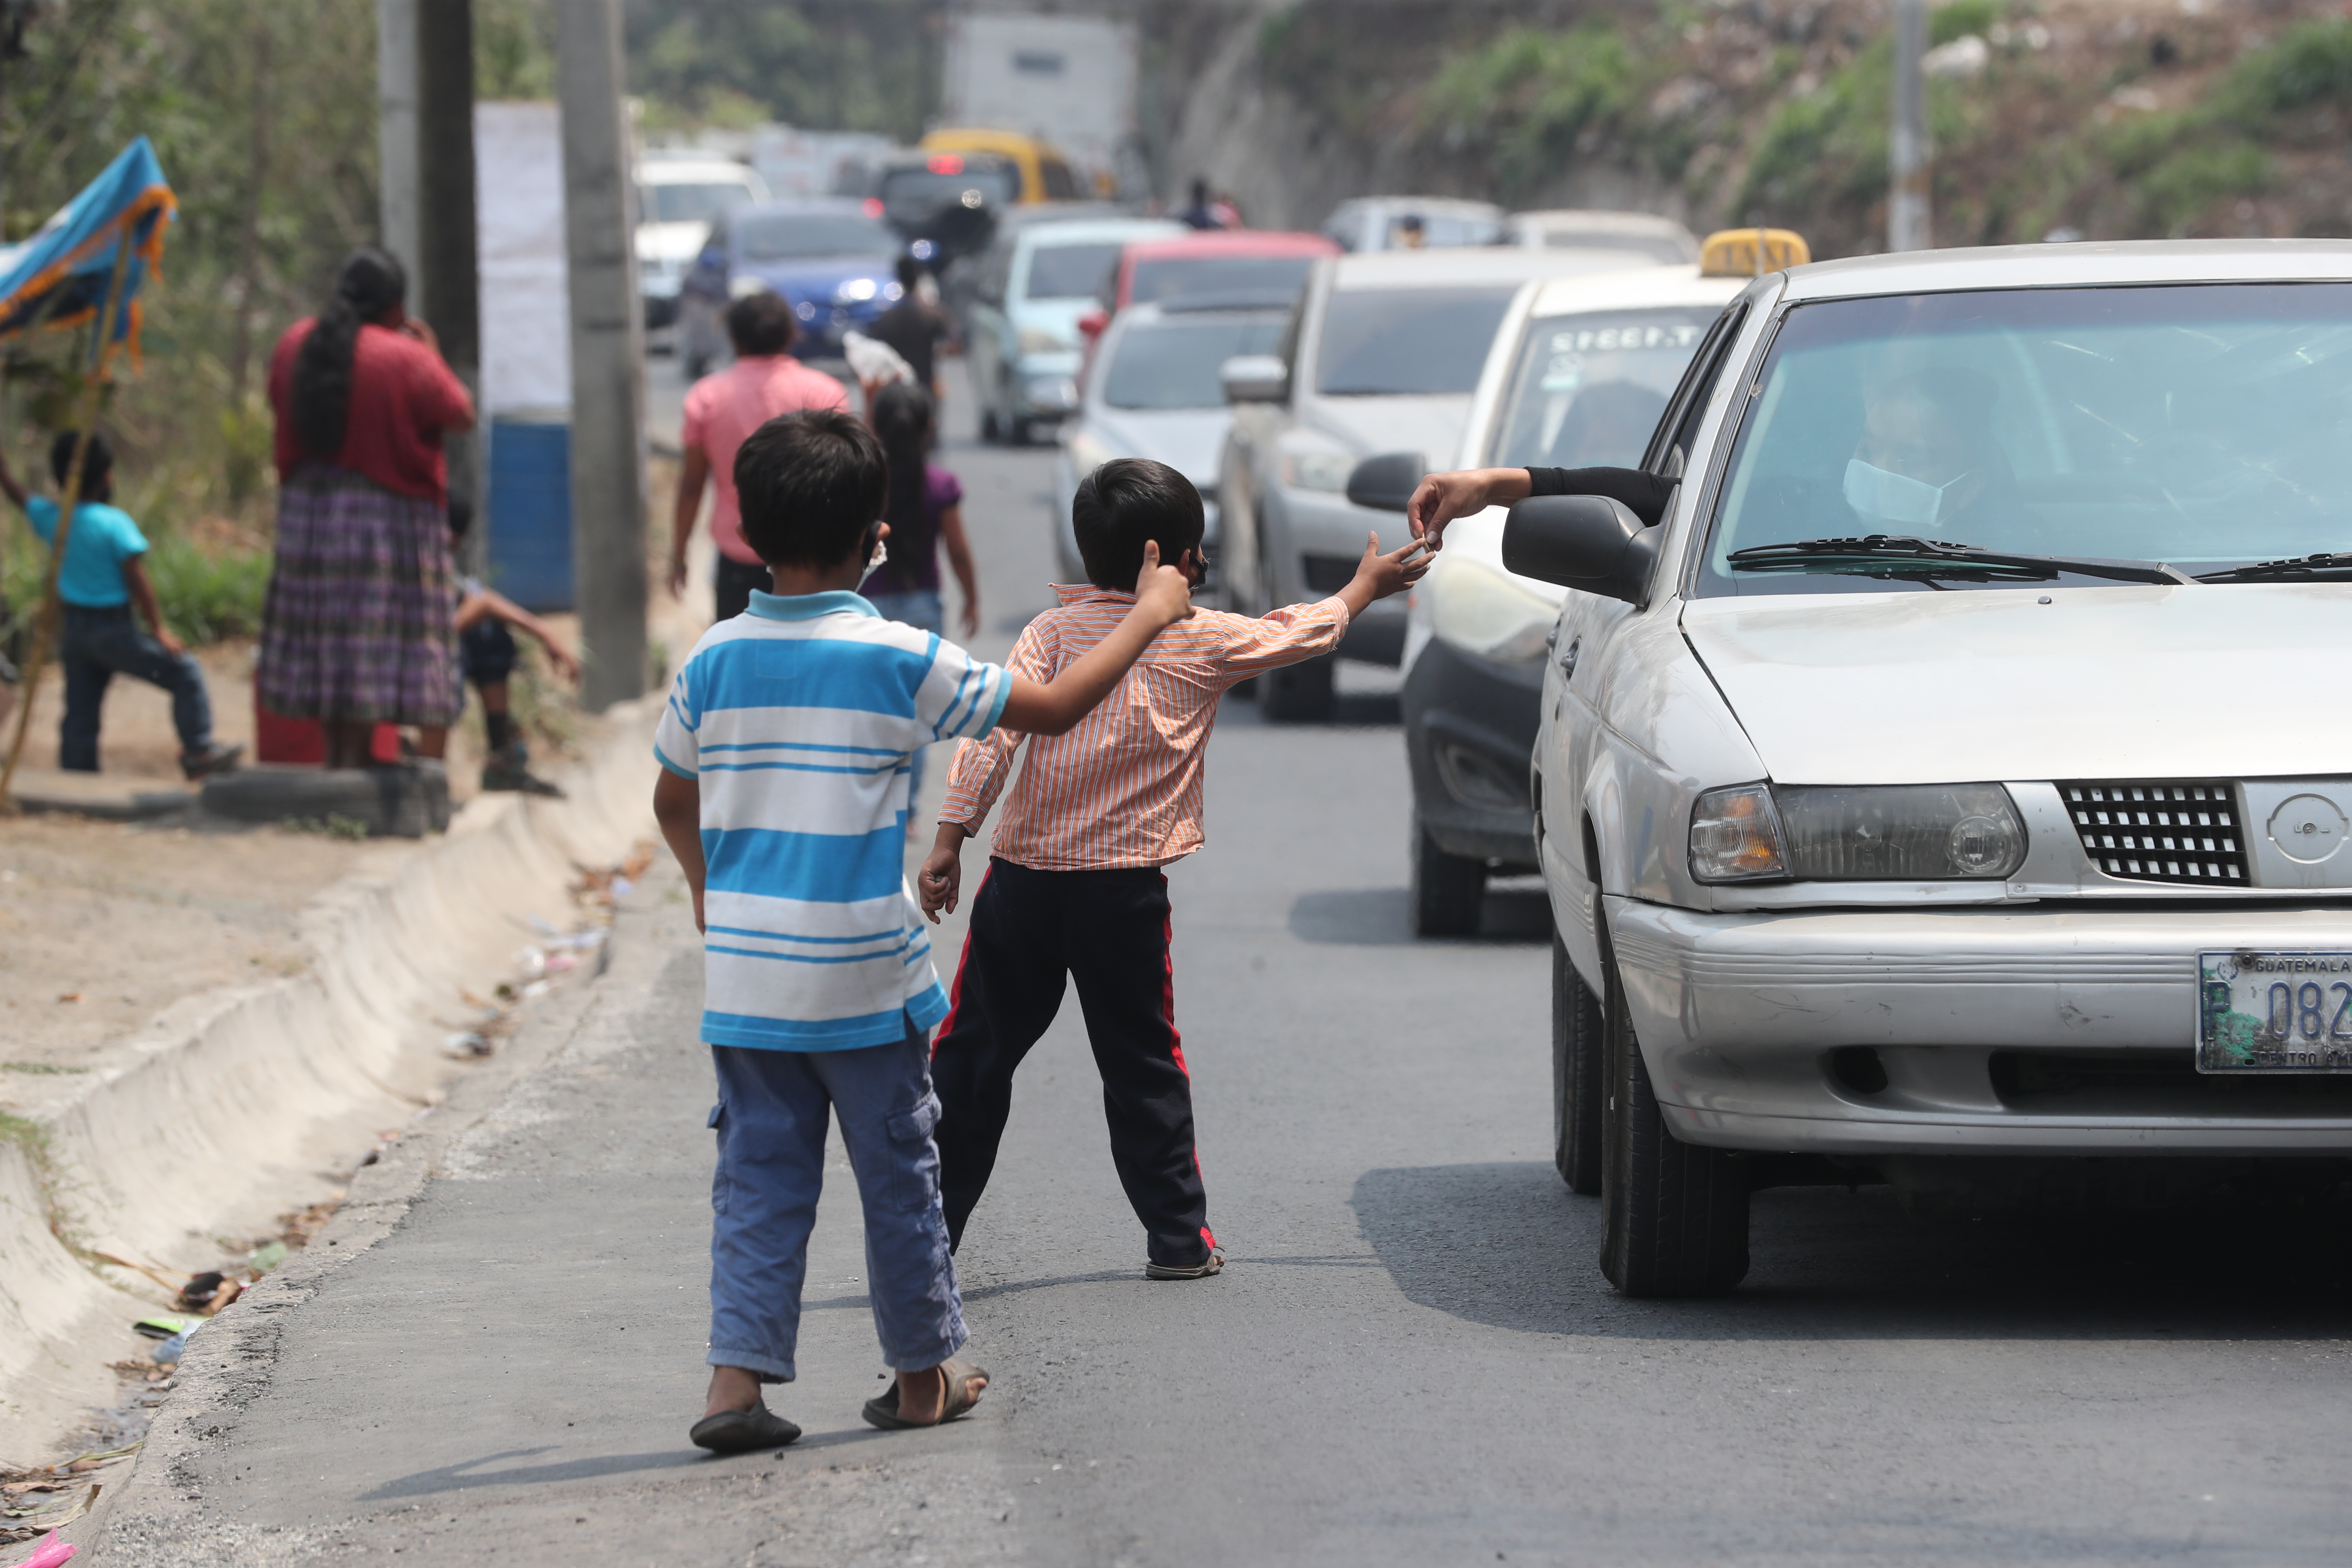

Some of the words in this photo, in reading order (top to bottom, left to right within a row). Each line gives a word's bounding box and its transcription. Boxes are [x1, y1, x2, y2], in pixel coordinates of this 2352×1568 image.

[2256, 959, 2351, 972] GUATEMALA
[2206, 980, 2231, 1040] P
[2260, 1051, 2316, 1064] CENTRO
